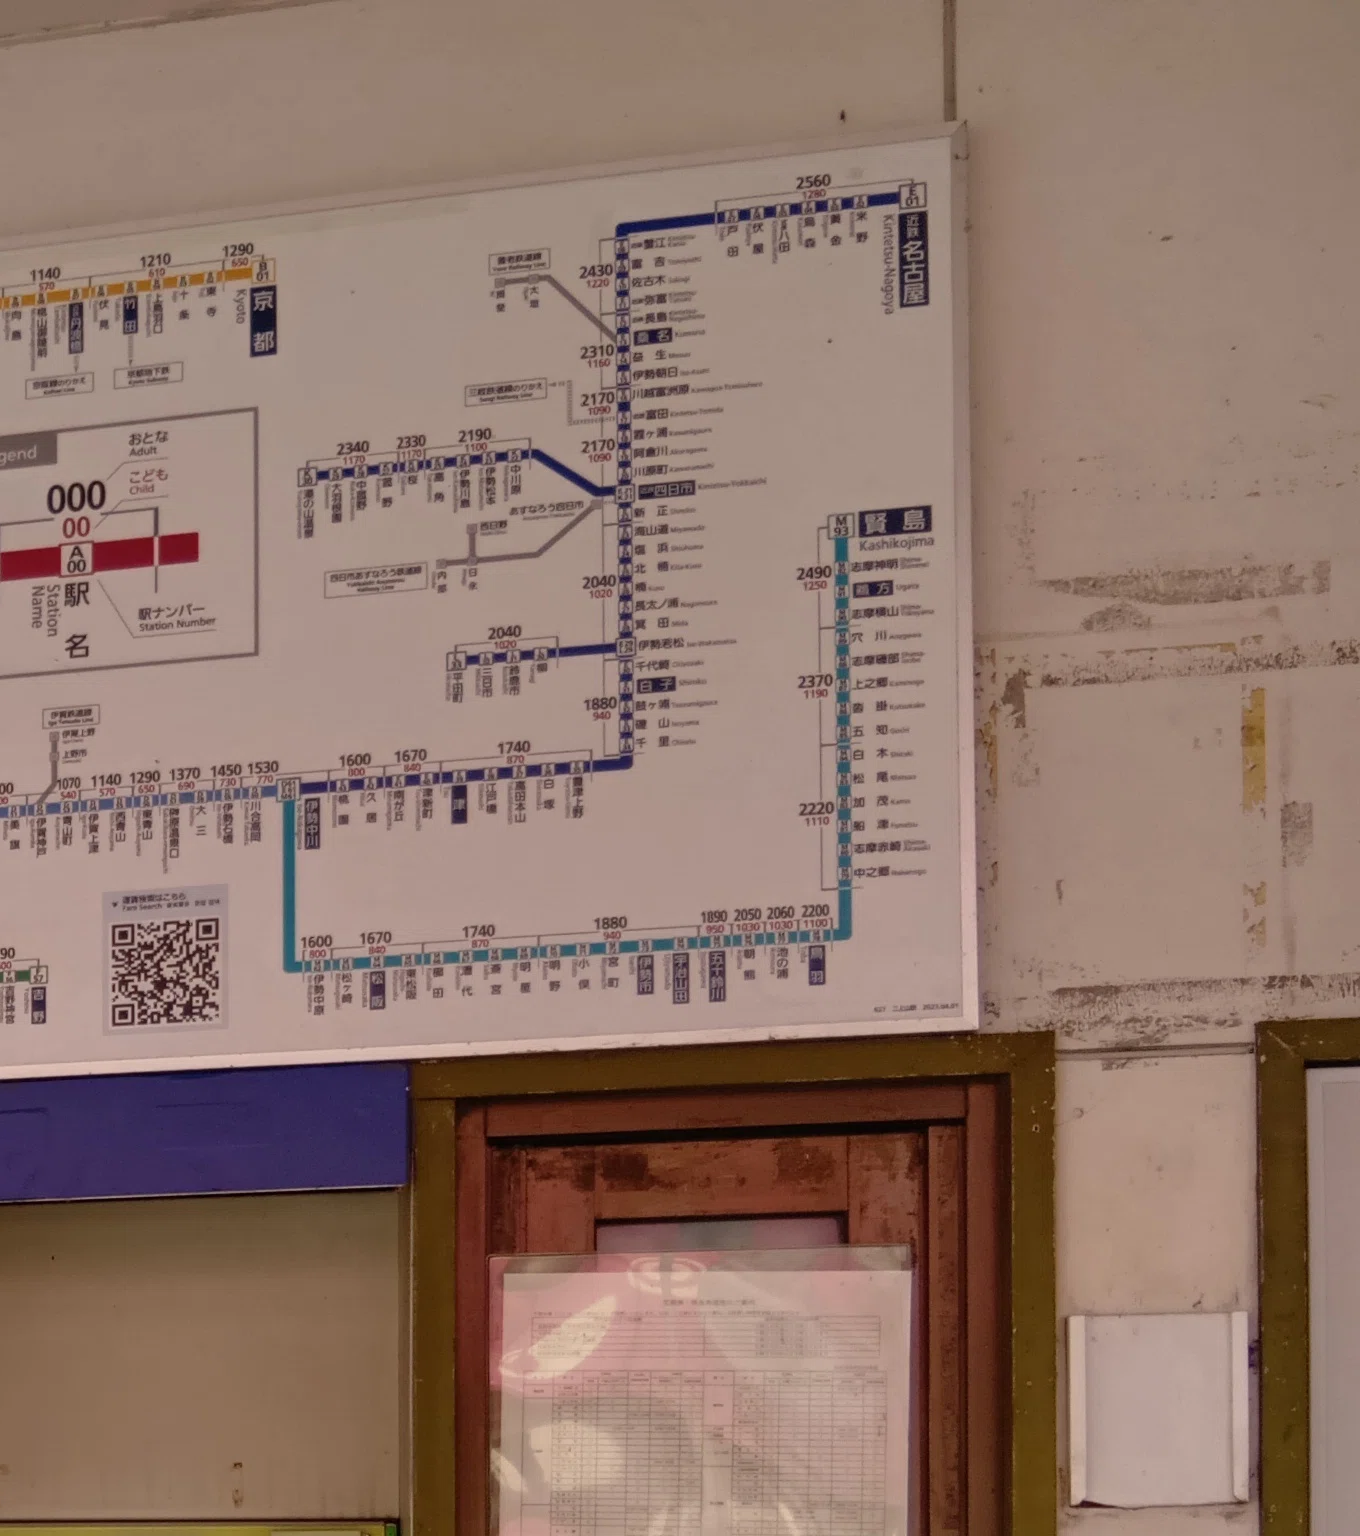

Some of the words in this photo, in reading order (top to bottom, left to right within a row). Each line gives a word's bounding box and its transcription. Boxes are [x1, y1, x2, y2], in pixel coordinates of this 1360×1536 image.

[796, 174, 831, 189] 2560
[223, 243, 254, 257] 1290
[140, 253, 171, 267] 1210
[883, 214, 895, 315] Kintetsu-Nagoya
[902, 214, 926, 305] 近鉄名古屋
[579, 264, 613, 278] 2430
[236, 289, 247, 324] Kyoto
[252, 290, 275, 353] 京都
[581, 393, 615, 406] 2170
[129, 431, 168, 445] おとな
[458, 428, 492, 442] 2190
[129, 446, 157, 456] Adult
[129, 468, 168, 483] こども
[47, 480, 106, 514] 000
[129, 484, 154, 495] Child
[62, 517, 90, 538] 00
[864, 510, 927, 534] 賢島
[859, 536, 935, 552] Kashikojima
[796, 566, 832, 580] 2490
[32, 586, 43, 629] Name
[47, 585, 60, 637] Station
[138, 605, 205, 619] 駅ナンバー
[139, 619, 174, 632] Station
[176, 616, 216, 628] Number
[798, 674, 833, 689] 2370
[497, 741, 531, 754] 1740
[799, 802, 834, 816] 2220
